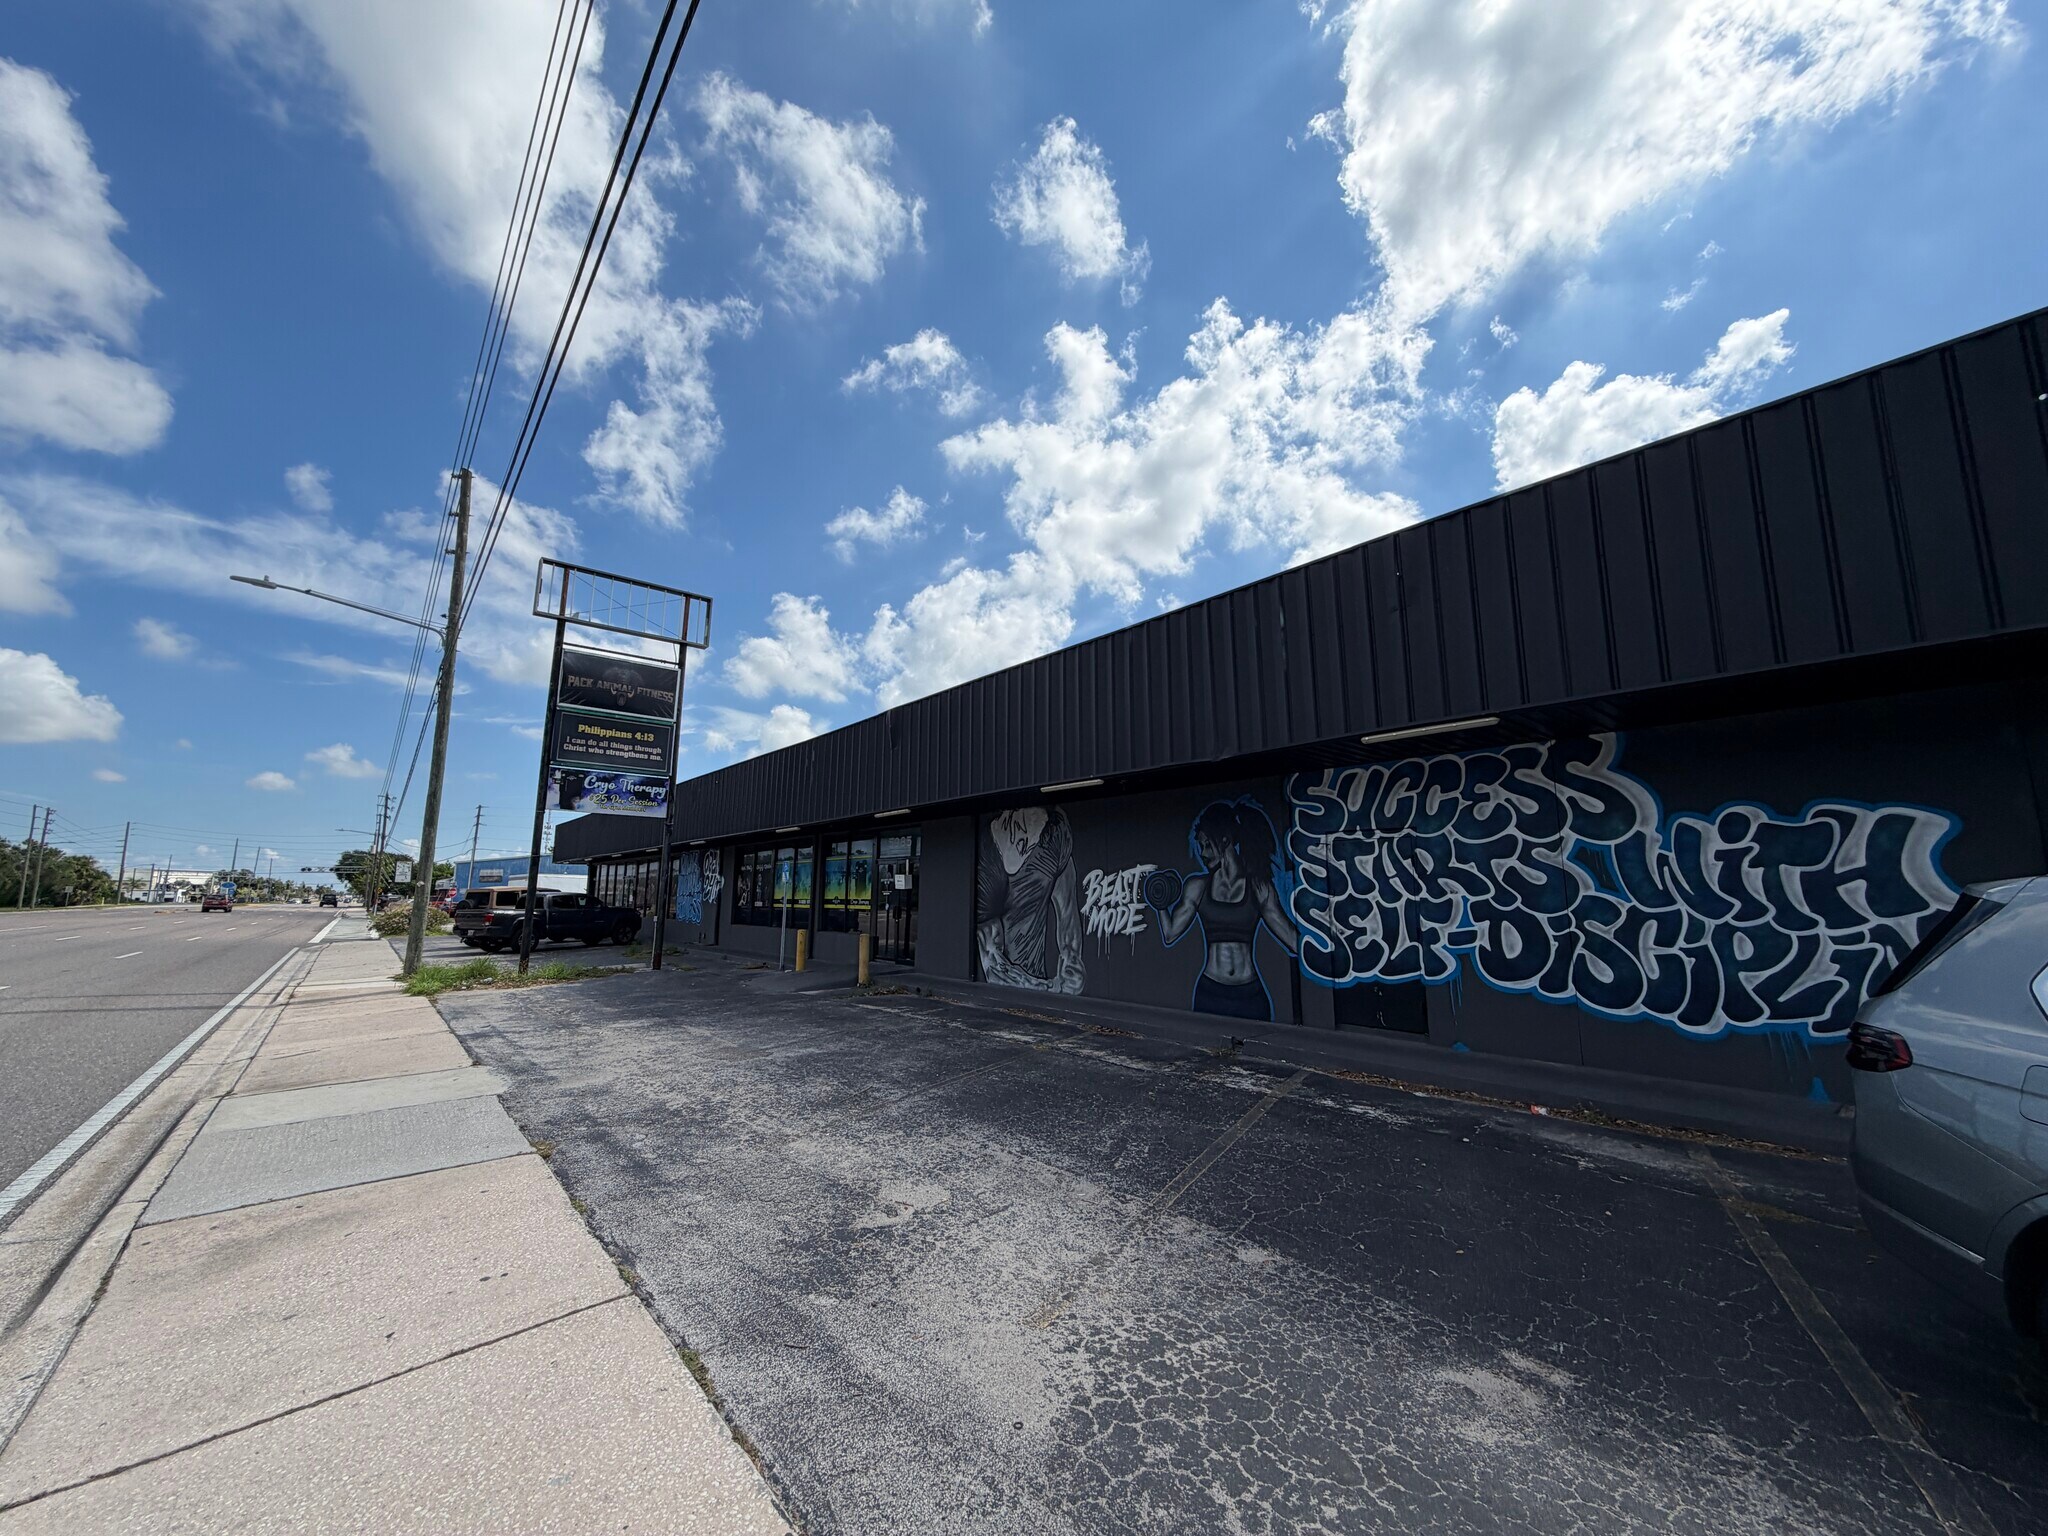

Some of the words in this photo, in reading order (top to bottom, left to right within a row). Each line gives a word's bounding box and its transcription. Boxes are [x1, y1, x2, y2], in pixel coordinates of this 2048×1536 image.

[567, 675, 594, 688] PACK
[596, 680, 634, 694] ANIMAL
[636, 686, 675, 703] FITNESS
[566, 735, 570, 743] I
[571, 737, 586, 745] can
[598, 740, 609, 748] all
[610, 741, 633, 751] things
[634, 744, 662, 754] through
[577, 724, 633, 739] Philippians
[634, 731, 655, 742] 4:13
[563, 743, 587, 753] Christ
[588, 747, 604, 755] who
[605, 748, 649, 759] strengthens
[583, 774, 617, 794] Cryo
[619, 778, 667, 799] Therapy
[1290, 732, 1660, 845] SUCCESS
[610, 793, 626, 804] Per
[628, 795, 659, 807] Session
[1288, 828, 1597, 918] STARTS
[1081, 864, 1158, 912] BEAST
[1086, 902, 1149, 938] MODE
